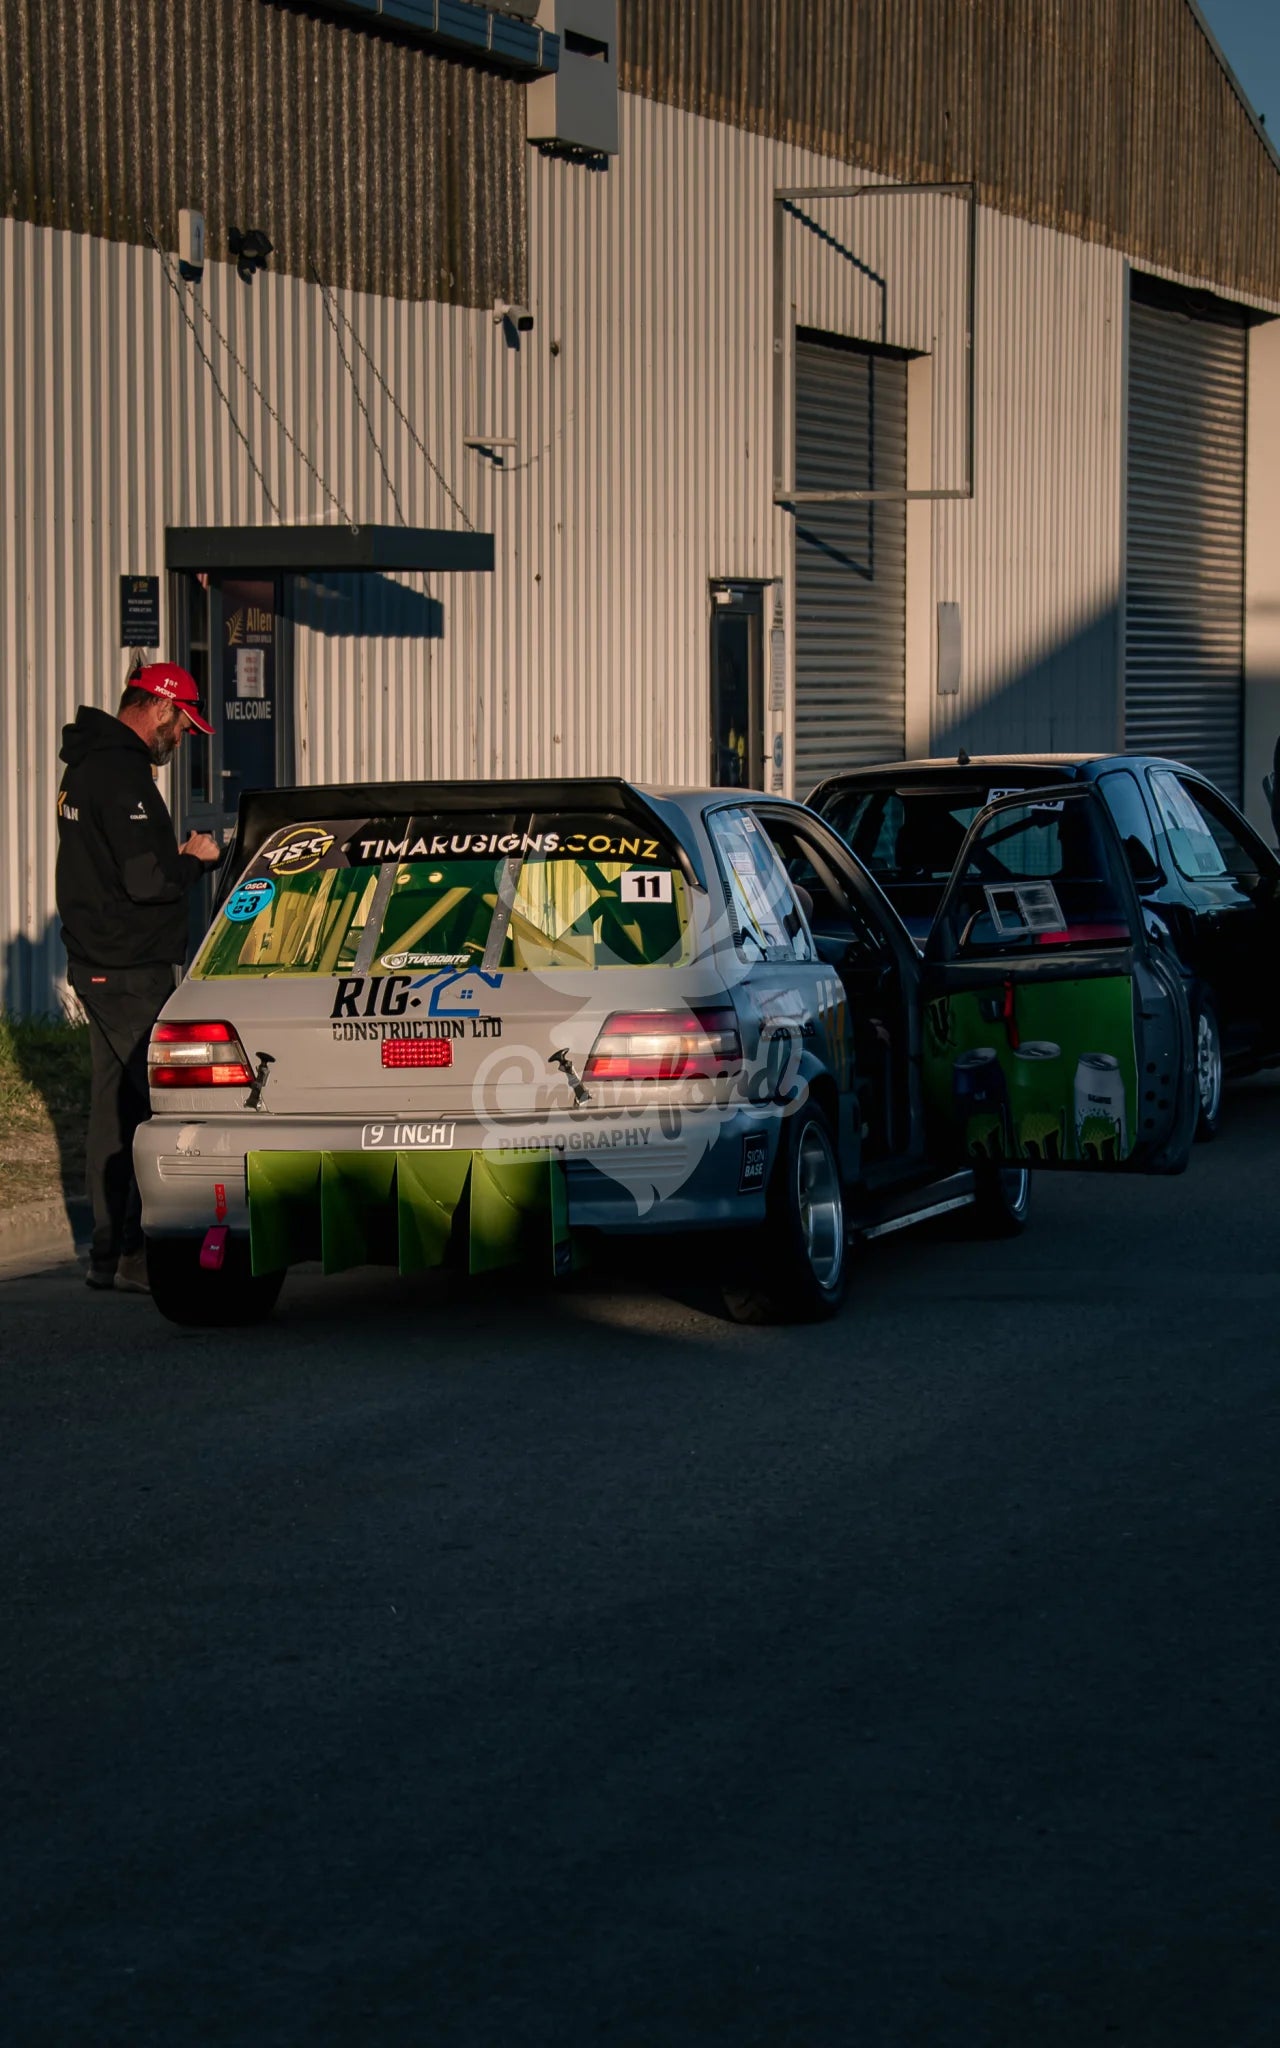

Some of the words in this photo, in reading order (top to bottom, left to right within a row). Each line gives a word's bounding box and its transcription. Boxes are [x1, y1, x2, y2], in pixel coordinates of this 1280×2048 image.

[246, 608, 272, 632] Allen
[225, 701, 272, 720] WELCOME
[244, 882, 268, 890] OSCA
[632, 875, 661, 898] 11
[244, 896, 261, 913] 3
[407, 954, 471, 966] TURBOBITS
[332, 1020, 465, 1041] CONSTRUCTION
[472, 1019, 502, 1038] LTD
[371, 1125, 385, 1145] 9
[393, 1124, 447, 1144] INCH
[746, 1149, 765, 1164] SIGN
[744, 1162, 764, 1177] BASE
